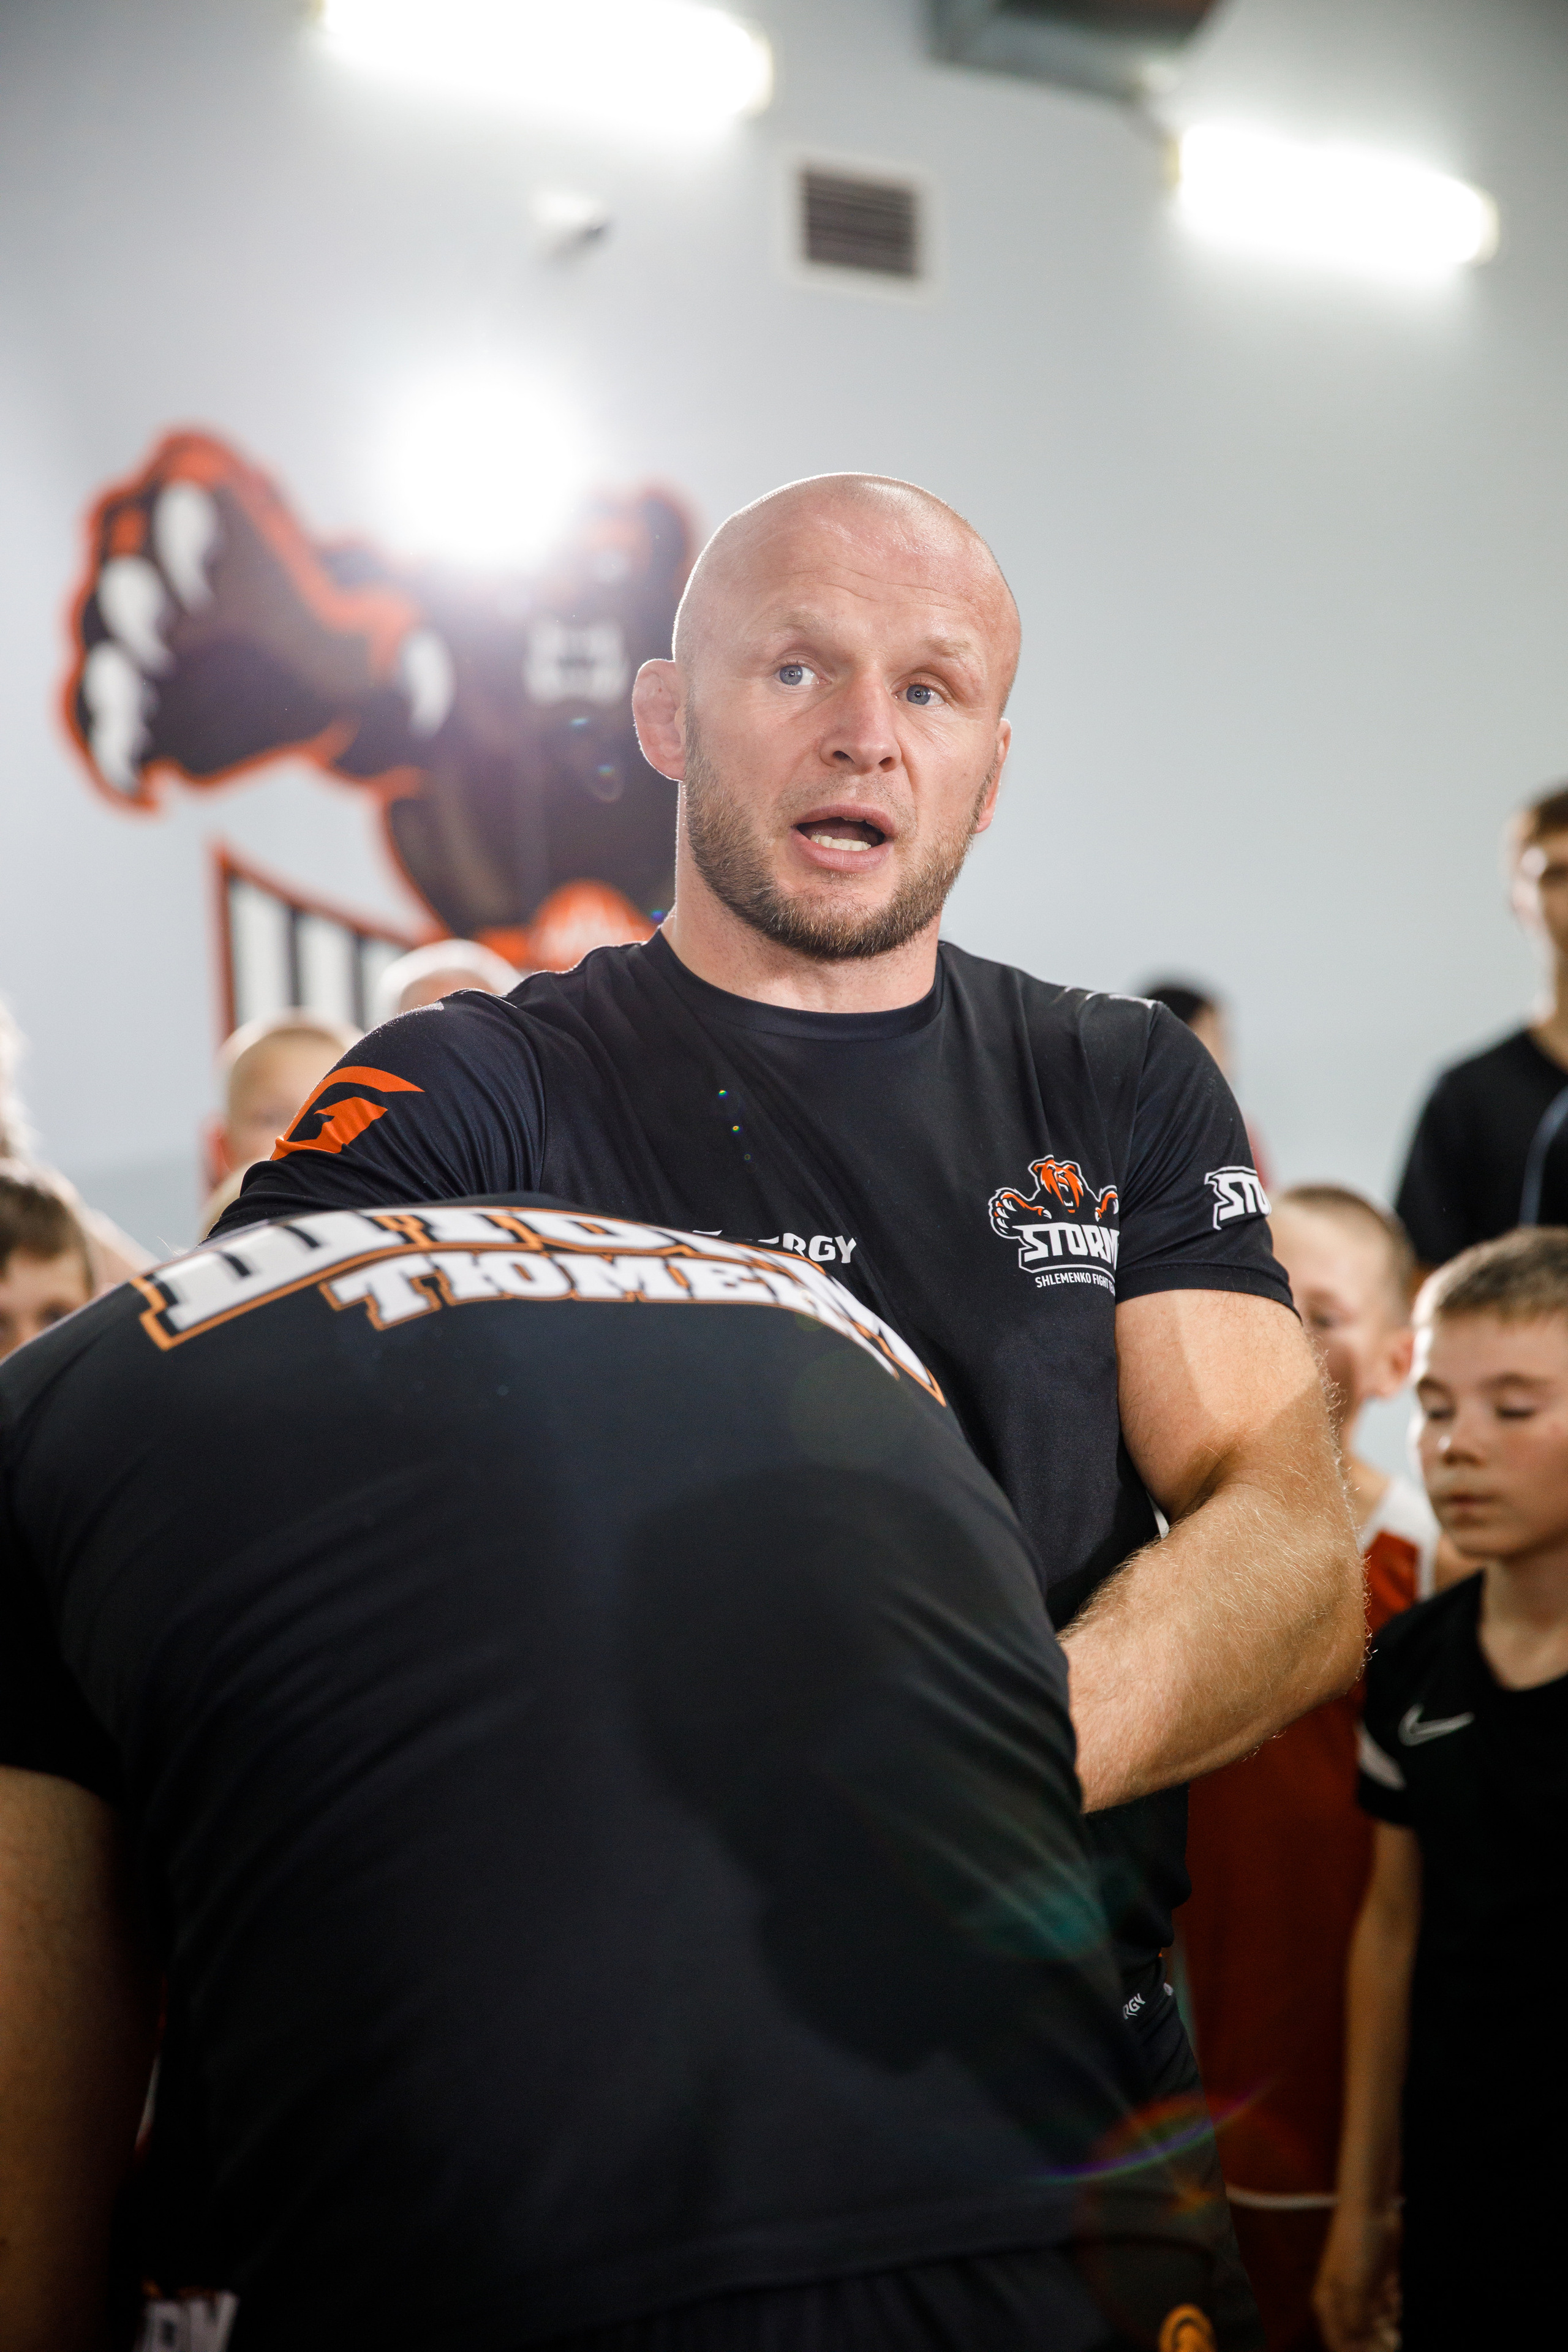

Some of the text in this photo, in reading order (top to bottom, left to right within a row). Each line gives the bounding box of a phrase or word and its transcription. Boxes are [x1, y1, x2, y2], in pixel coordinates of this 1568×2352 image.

[1212, 1172, 1272, 1221] STO
[1012, 1222, 1120, 1271] STORM
[1035, 1272, 1091, 1288] SHLEMENKO
[1092, 1274, 1109, 1289] FIGHT
